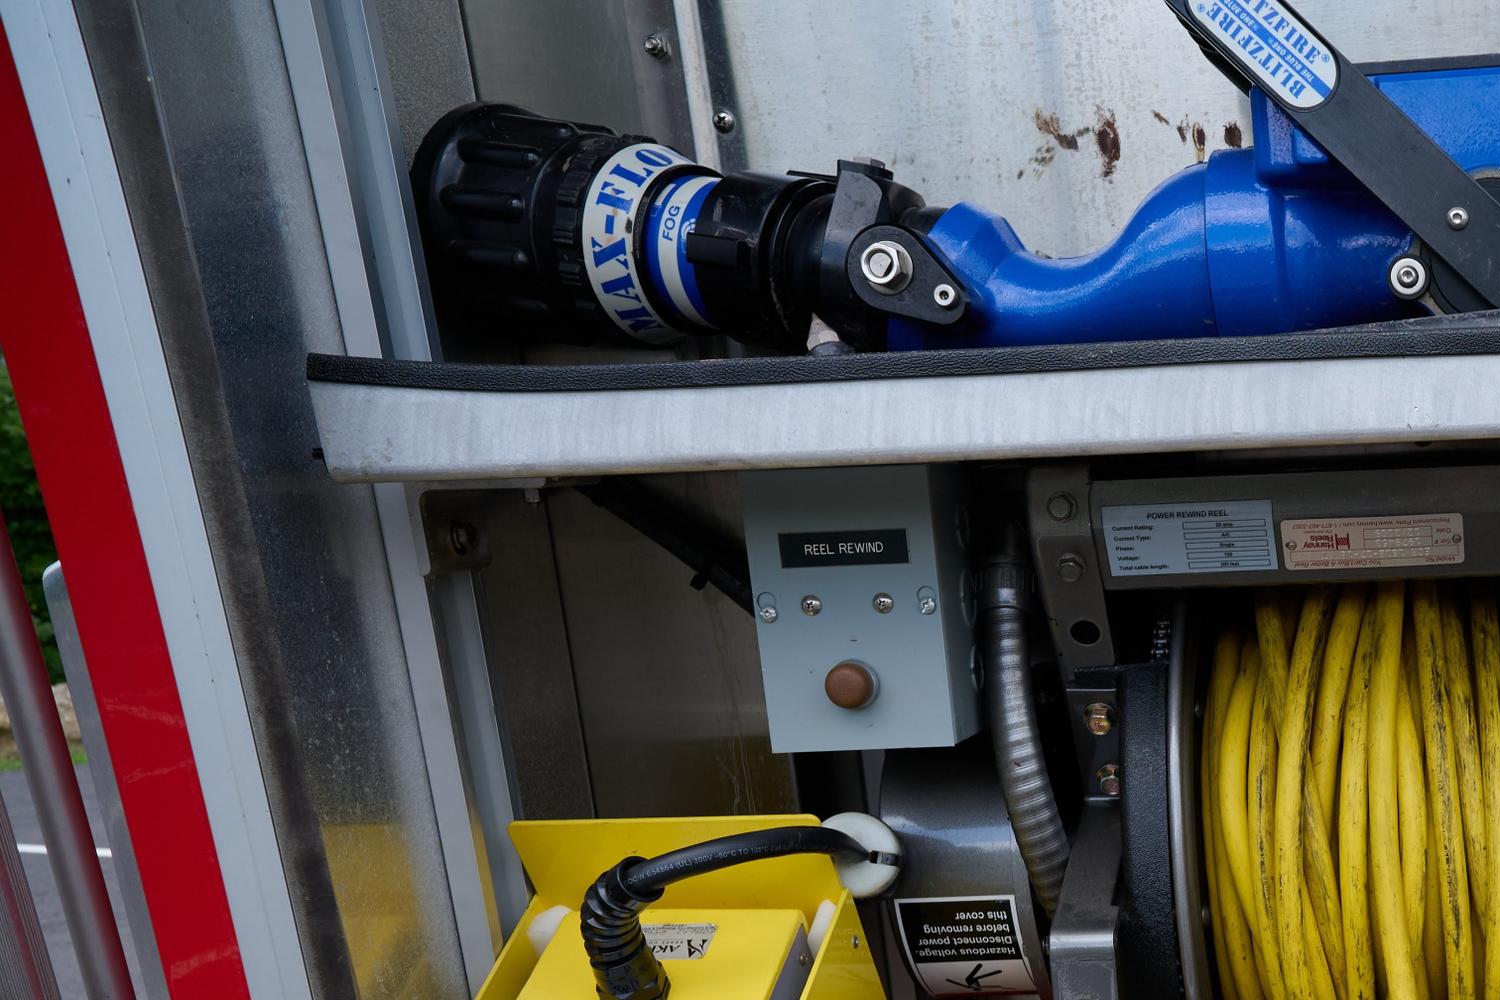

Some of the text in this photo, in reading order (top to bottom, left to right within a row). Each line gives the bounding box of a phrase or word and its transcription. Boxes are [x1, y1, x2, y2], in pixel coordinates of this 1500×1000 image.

[1271, 41, 1314, 82] THE BLUE ONE
[662, 205, 680, 242] FOG
[591, 148, 675, 334] MAX-FLO
[1147, 511, 1175, 520] POWER
[1176, 511, 1207, 519] REWIND
[1310, 534, 1334, 542] Reels
[804, 541, 884, 556] REEL REWIND
[1303, 541, 1335, 550] Hannay
[738, 848, 749, 856] TO
[955, 910, 1008, 920] this cover
[923, 923, 1010, 934] before removing
[918, 935, 1013, 946] Disconnect power
[915, 946, 1016, 957] Hazardous voltage.
